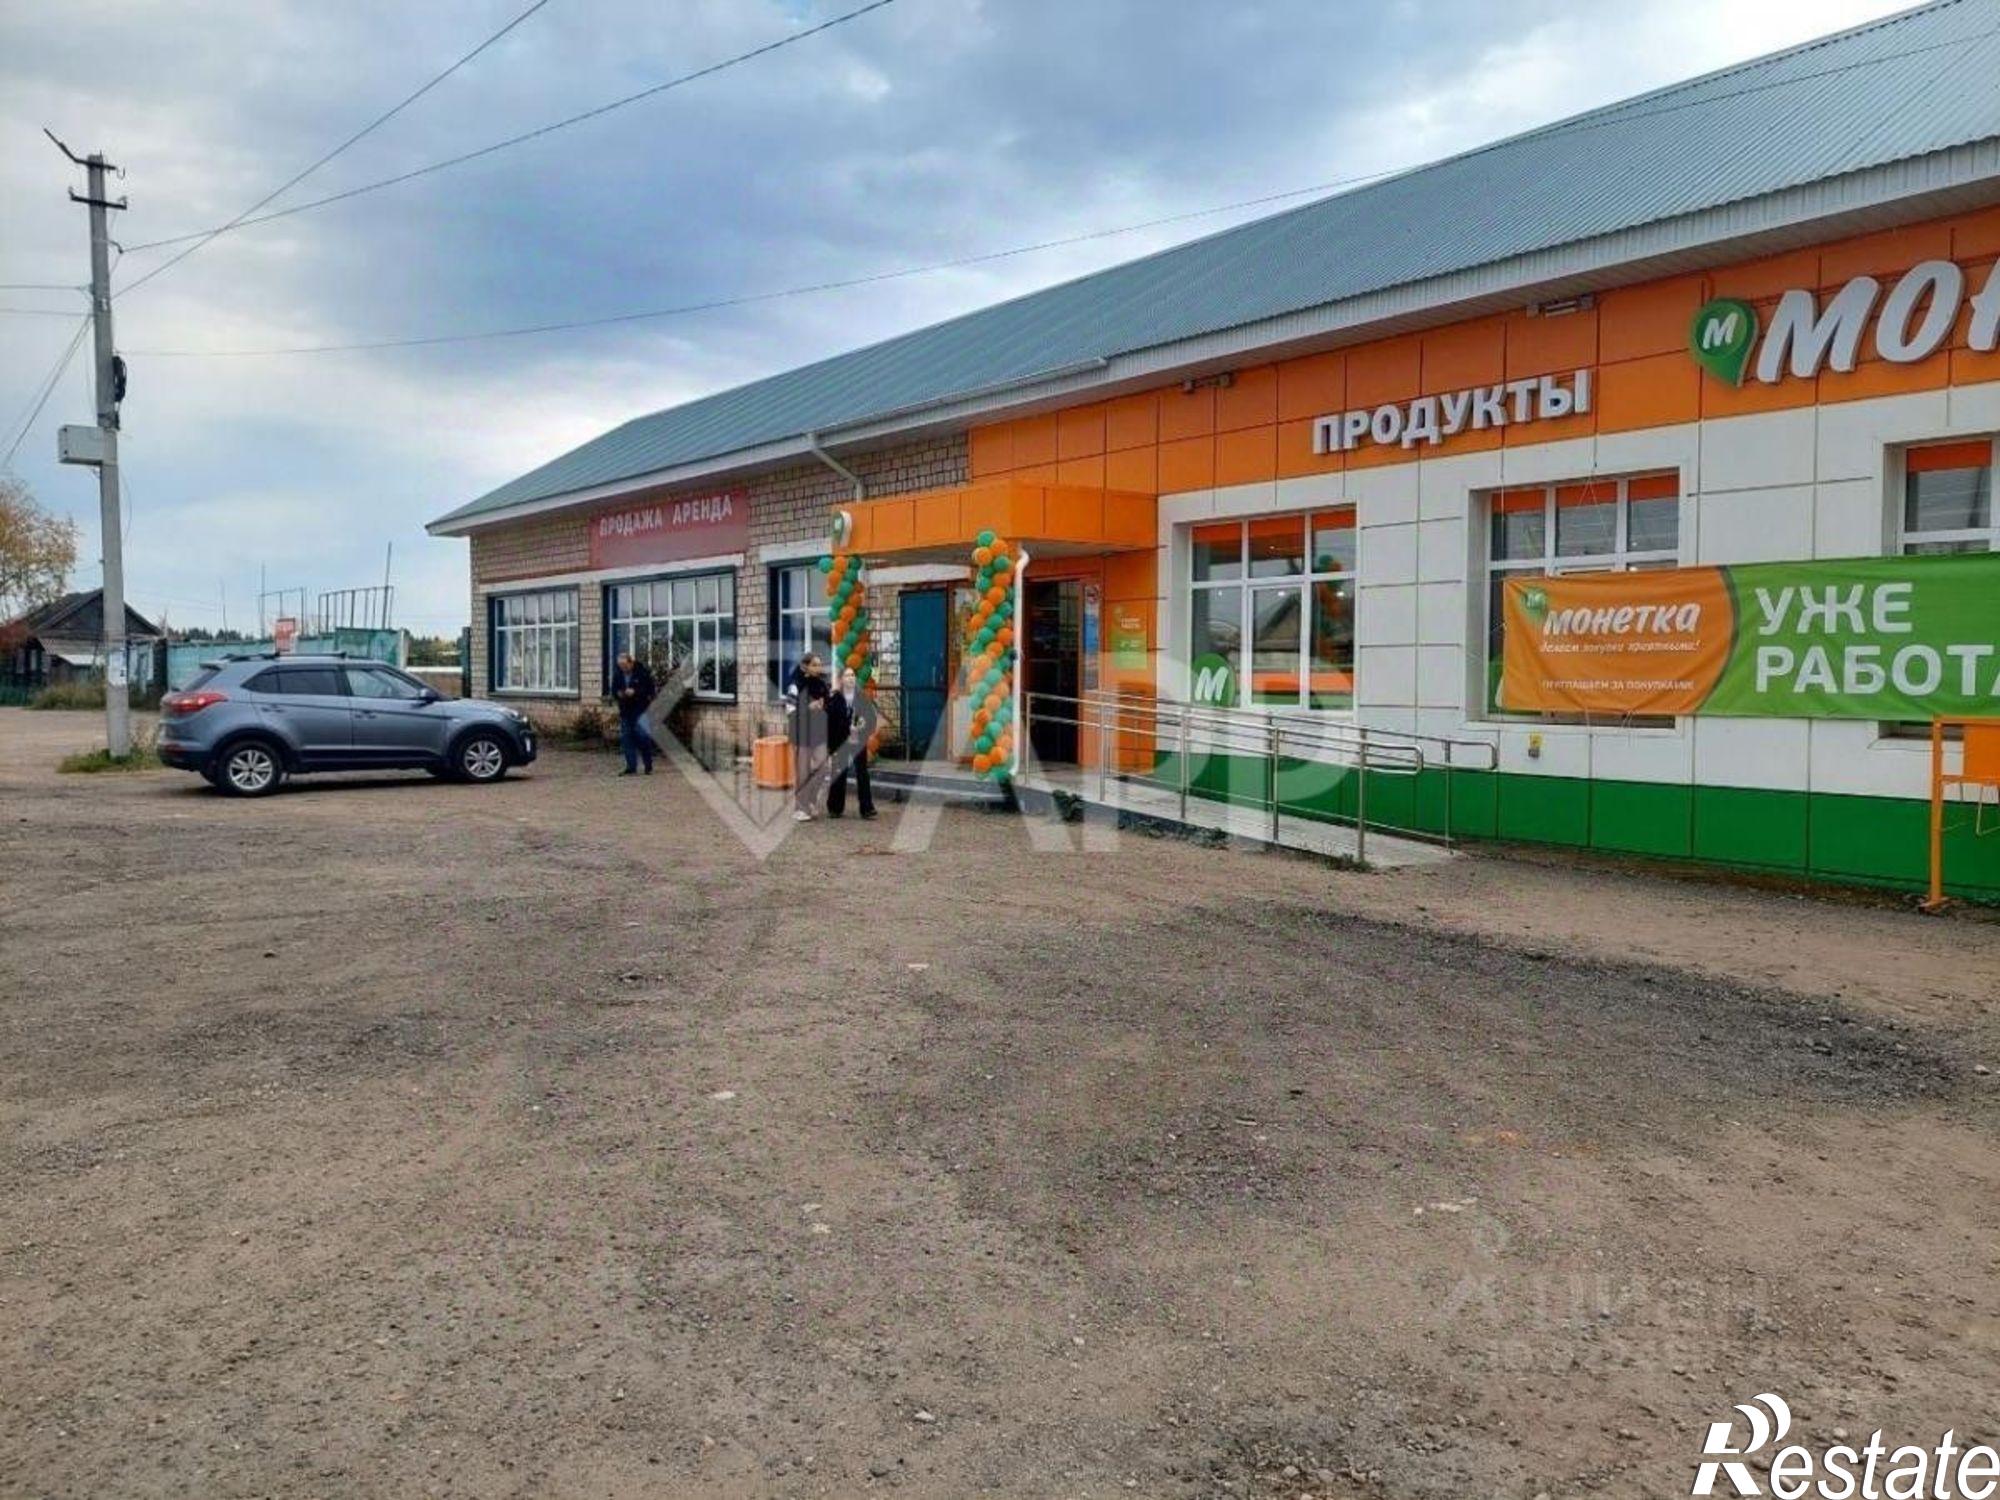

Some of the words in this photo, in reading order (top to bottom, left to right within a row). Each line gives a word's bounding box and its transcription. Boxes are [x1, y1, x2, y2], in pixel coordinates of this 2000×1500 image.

[1312, 368, 1592, 454] ПРОДУКТЫ
[600, 507, 662, 537] ПРОДАЖА
[672, 494, 732, 526] АРЕНДА
[1755, 582, 1913, 635] УЖЕ
[1756, 644, 2000, 696] РАБОТ
